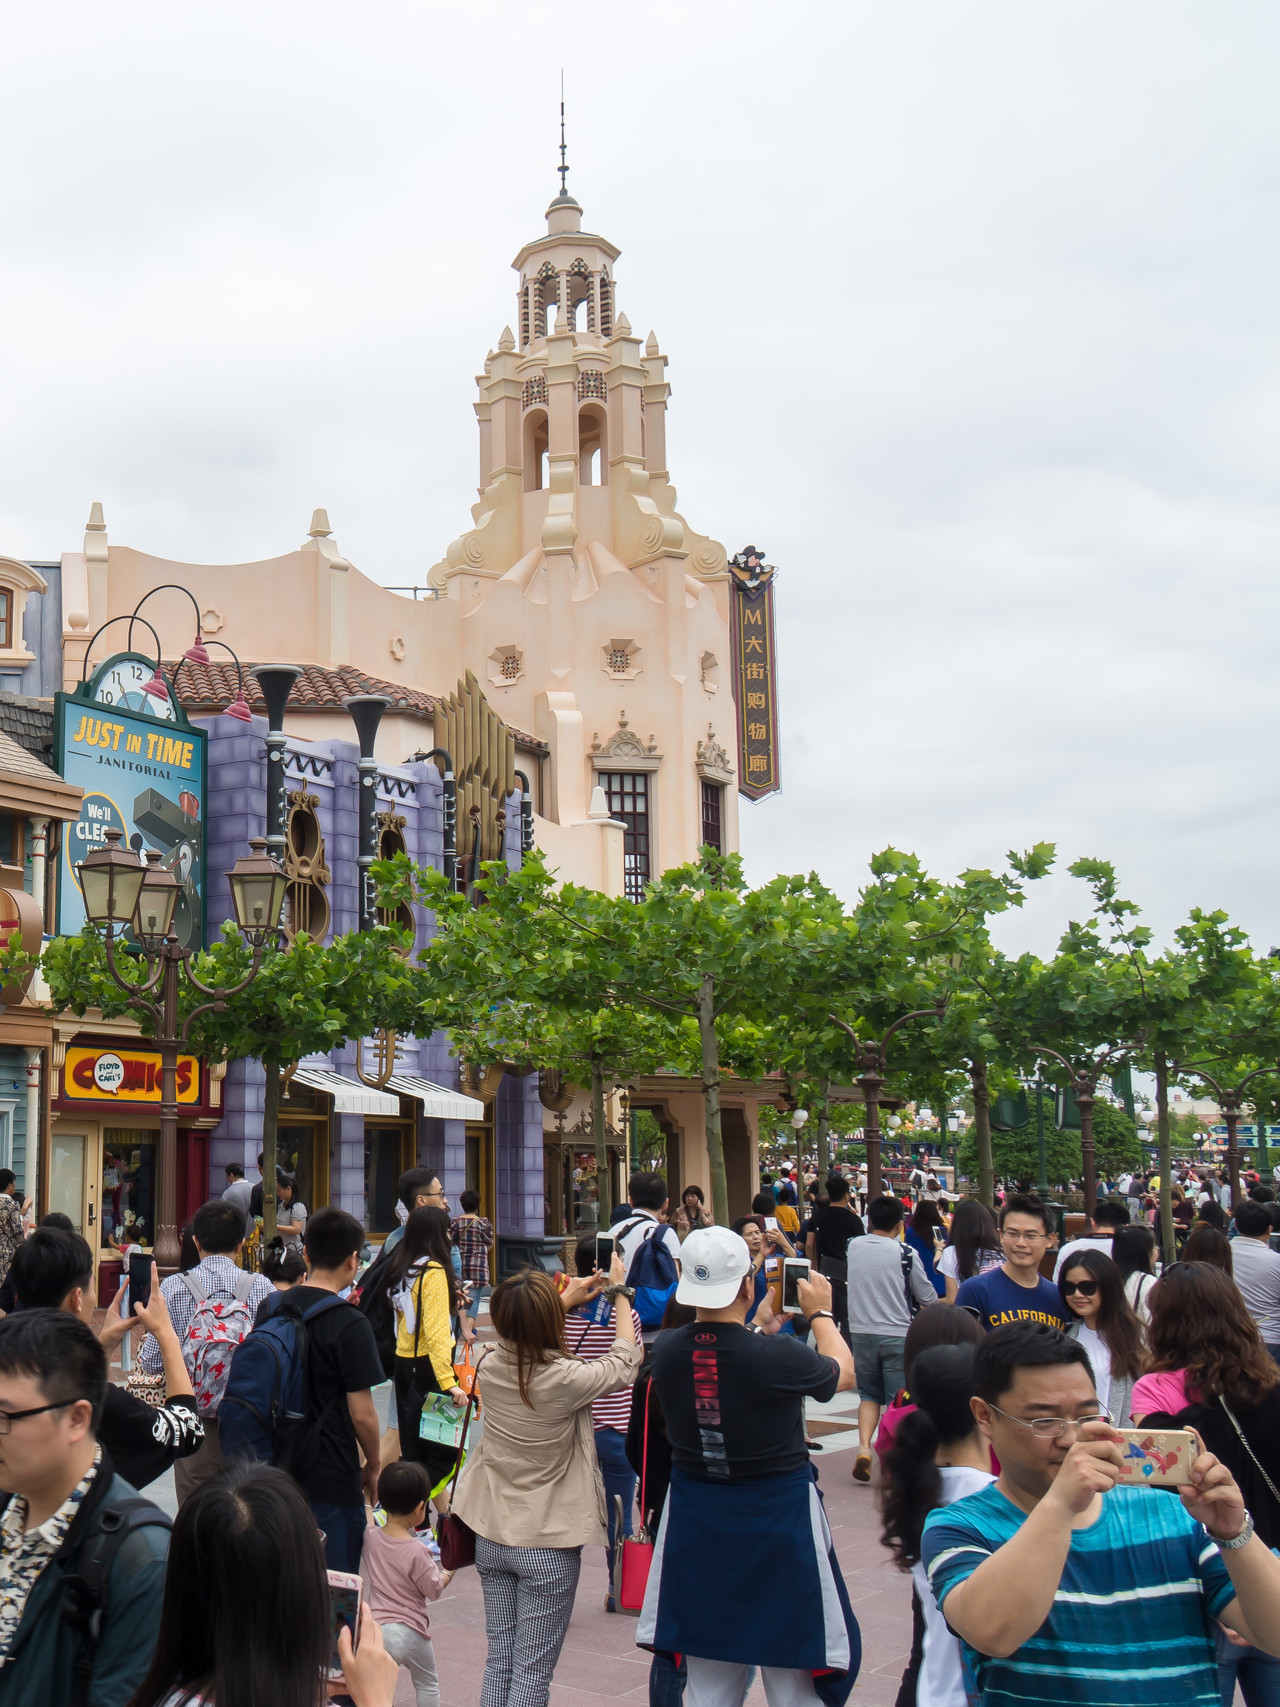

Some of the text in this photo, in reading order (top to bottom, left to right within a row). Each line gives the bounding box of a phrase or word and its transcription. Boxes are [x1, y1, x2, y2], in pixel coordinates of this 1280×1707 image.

[131, 665, 143, 681] 12
[73, 715, 194, 769] JUST IN TIME
[96, 754, 173, 781] JANITORIAL
[87, 803, 111, 822] We'll
[75, 821, 110, 844] CLEA
[98, 1062, 121, 1072] FLOYD
[98, 1073, 121, 1083] CARL'S
[692, 1350, 721, 1426] UNDER
